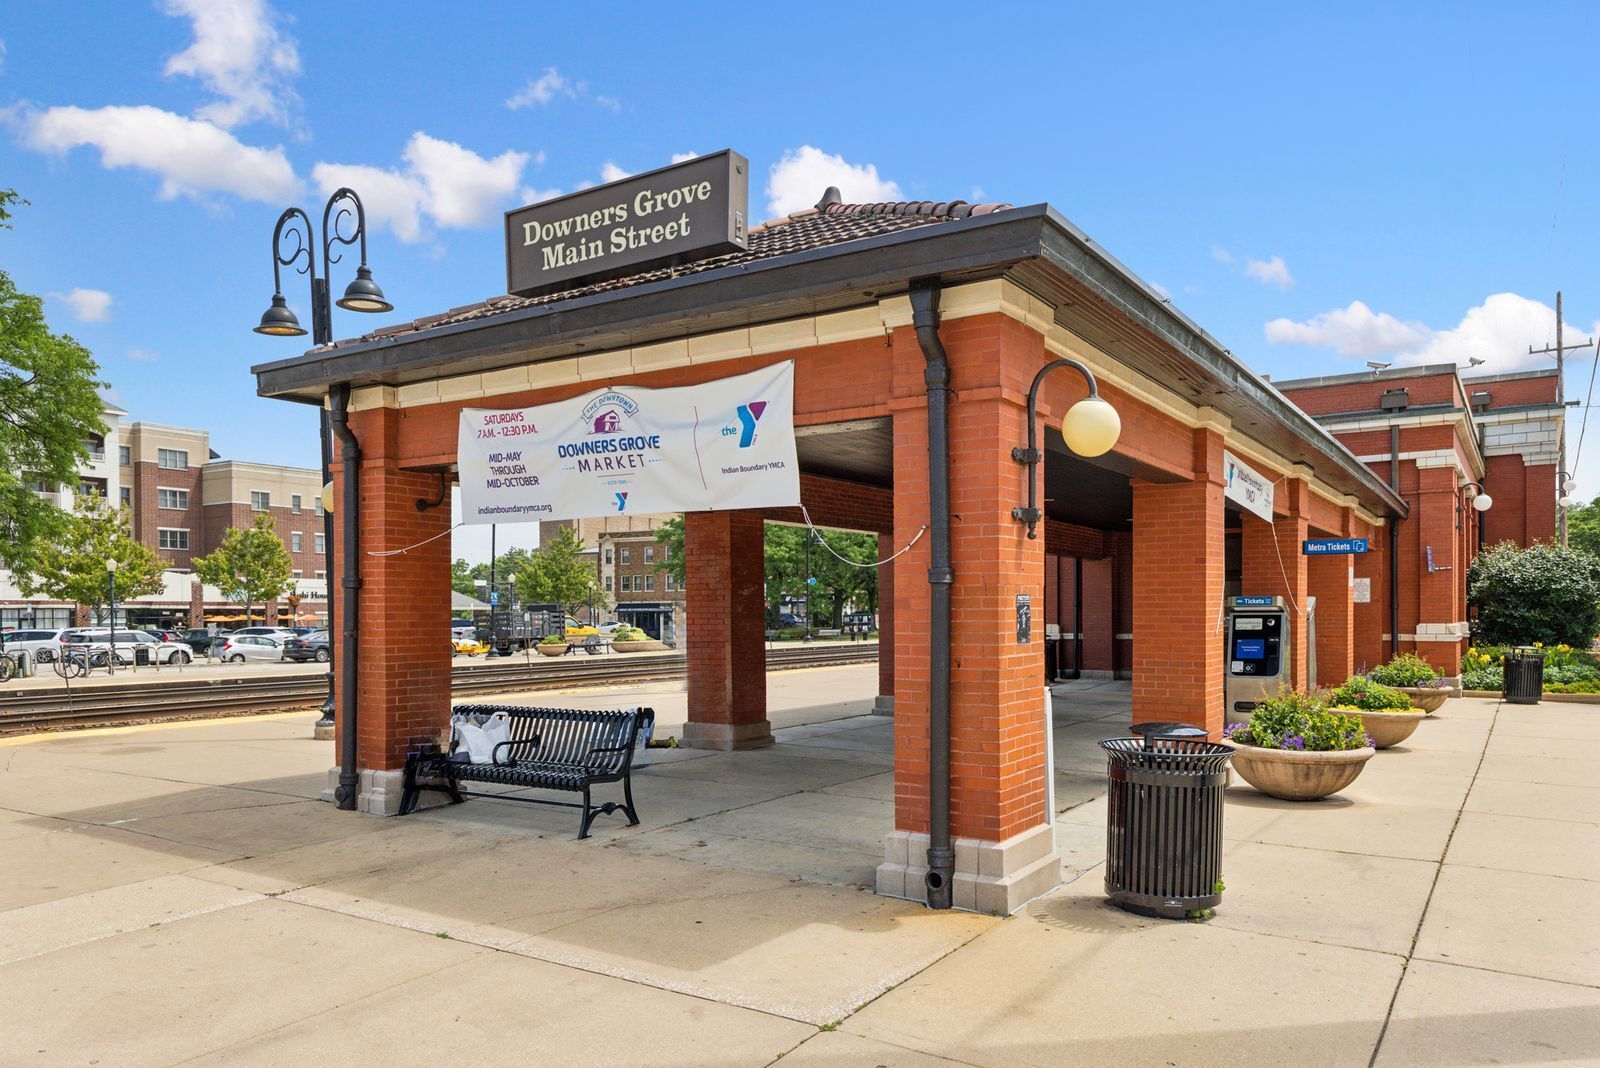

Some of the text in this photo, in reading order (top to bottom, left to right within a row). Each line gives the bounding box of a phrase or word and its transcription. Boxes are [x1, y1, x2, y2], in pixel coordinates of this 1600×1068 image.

[523, 181, 712, 246] Downers Grove
[542, 212, 691, 270] Main Street
[586, 394, 633, 413] THE DOWNTOWN
[484, 412, 524, 425] SATURDAYS
[477, 430, 481, 439] 7
[482, 428, 496, 439] A.M.
[502, 426, 520, 437] 12:30
[522, 424, 538, 435] P.M.
[721, 426, 737, 436] the
[558, 435, 660, 458] DOWNERS GROVE
[489, 451, 522, 463] MID-MAY
[578, 454, 645, 472] MARKET
[490, 465, 526, 475] THROUGH
[721, 461, 785, 474] Indian Boundary YMCA
[487, 476, 540, 488] MID-OCTOBER
[478, 504, 552, 515] indianboundaryymca.org
[1308, 543, 1350, 552] Metra Tickets
